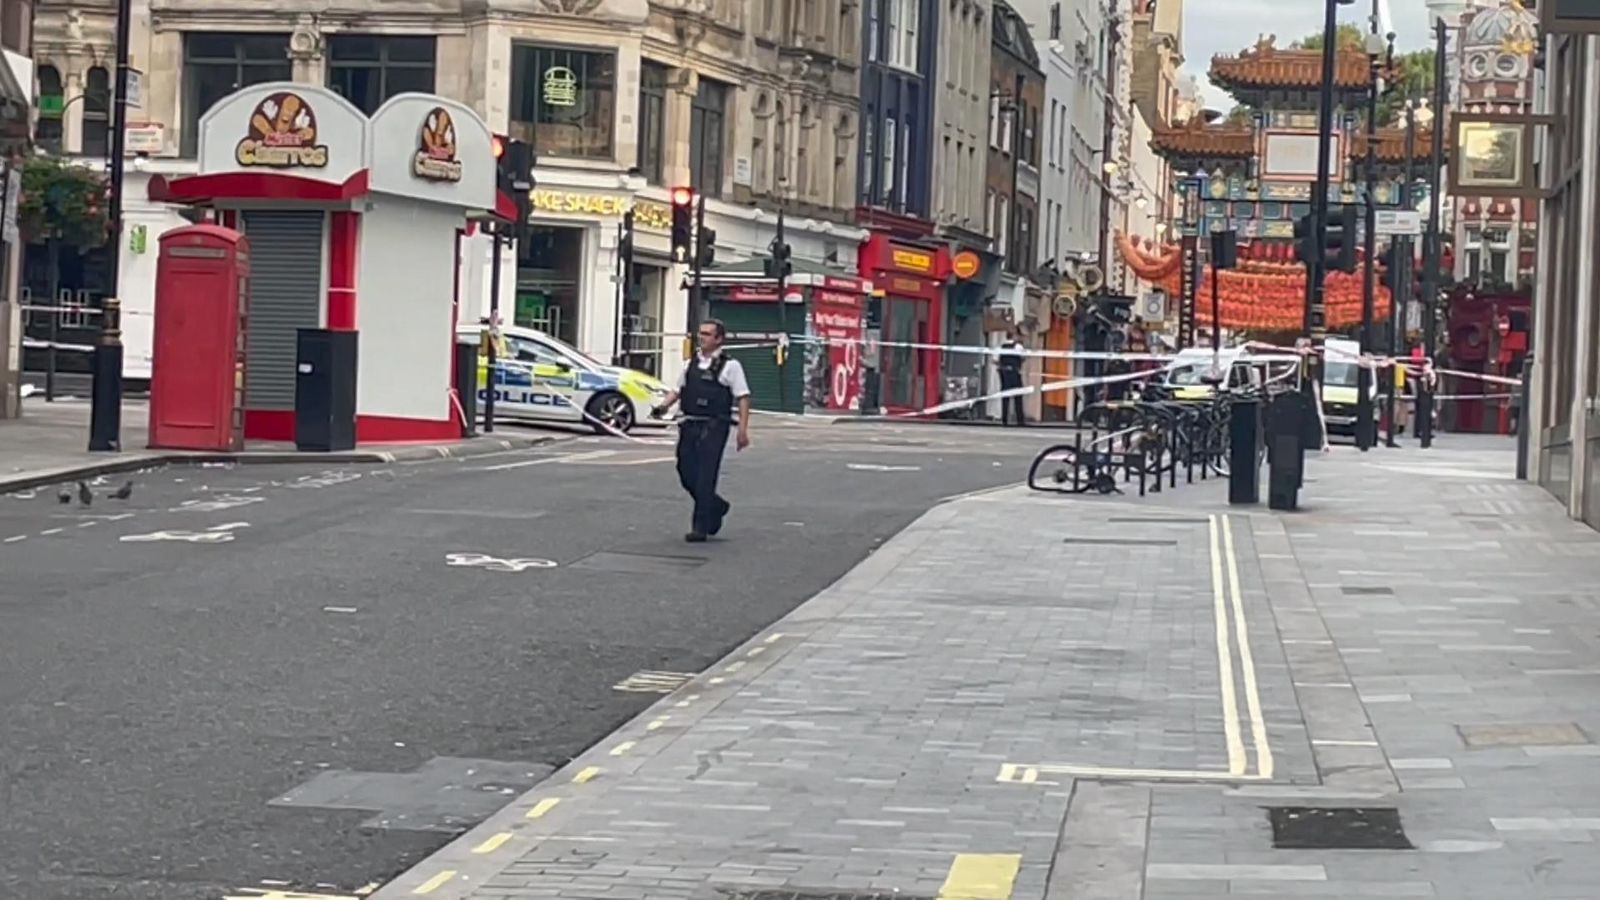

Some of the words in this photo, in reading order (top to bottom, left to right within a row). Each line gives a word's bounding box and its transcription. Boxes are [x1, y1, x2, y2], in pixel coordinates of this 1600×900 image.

[529, 190, 564, 211] AKE
[564, 192, 627, 215] SHACK
[477, 389, 573, 407] OLICE
